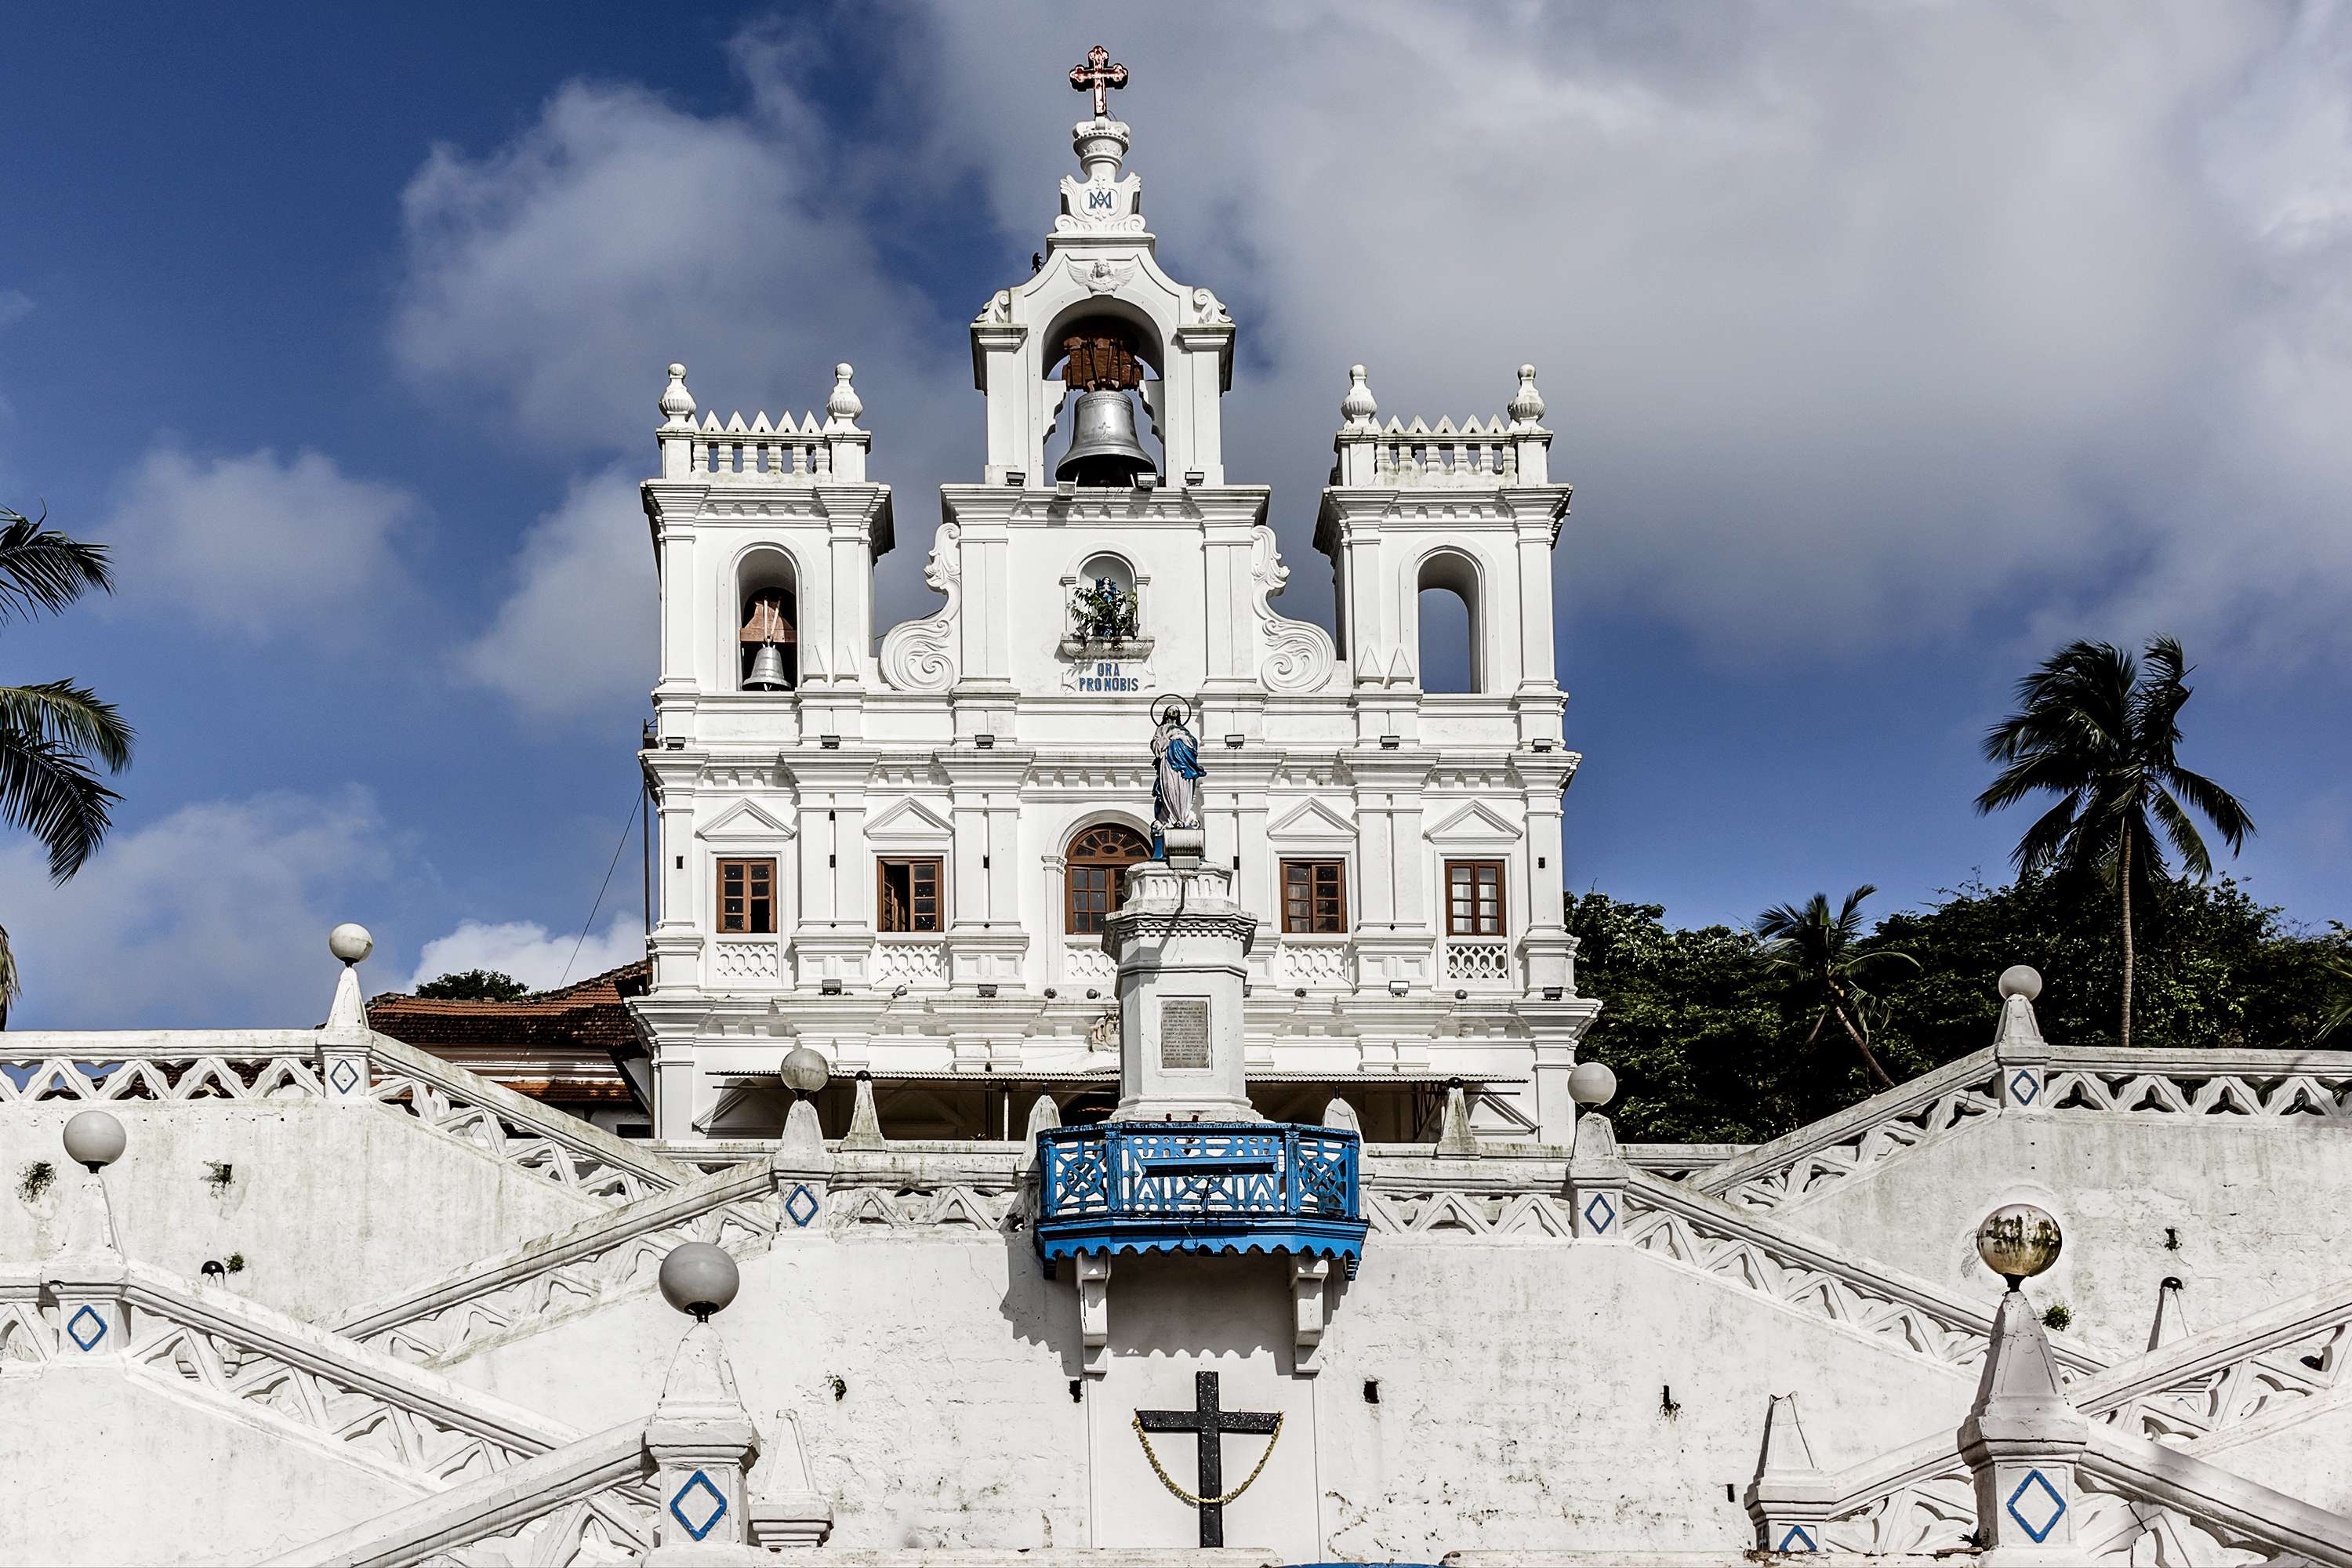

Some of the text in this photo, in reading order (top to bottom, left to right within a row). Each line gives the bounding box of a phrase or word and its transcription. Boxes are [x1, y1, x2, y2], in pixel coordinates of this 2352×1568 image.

[1098, 662, 1120, 677] ORA
[1079, 677, 1138, 691] PRO NOBIS
